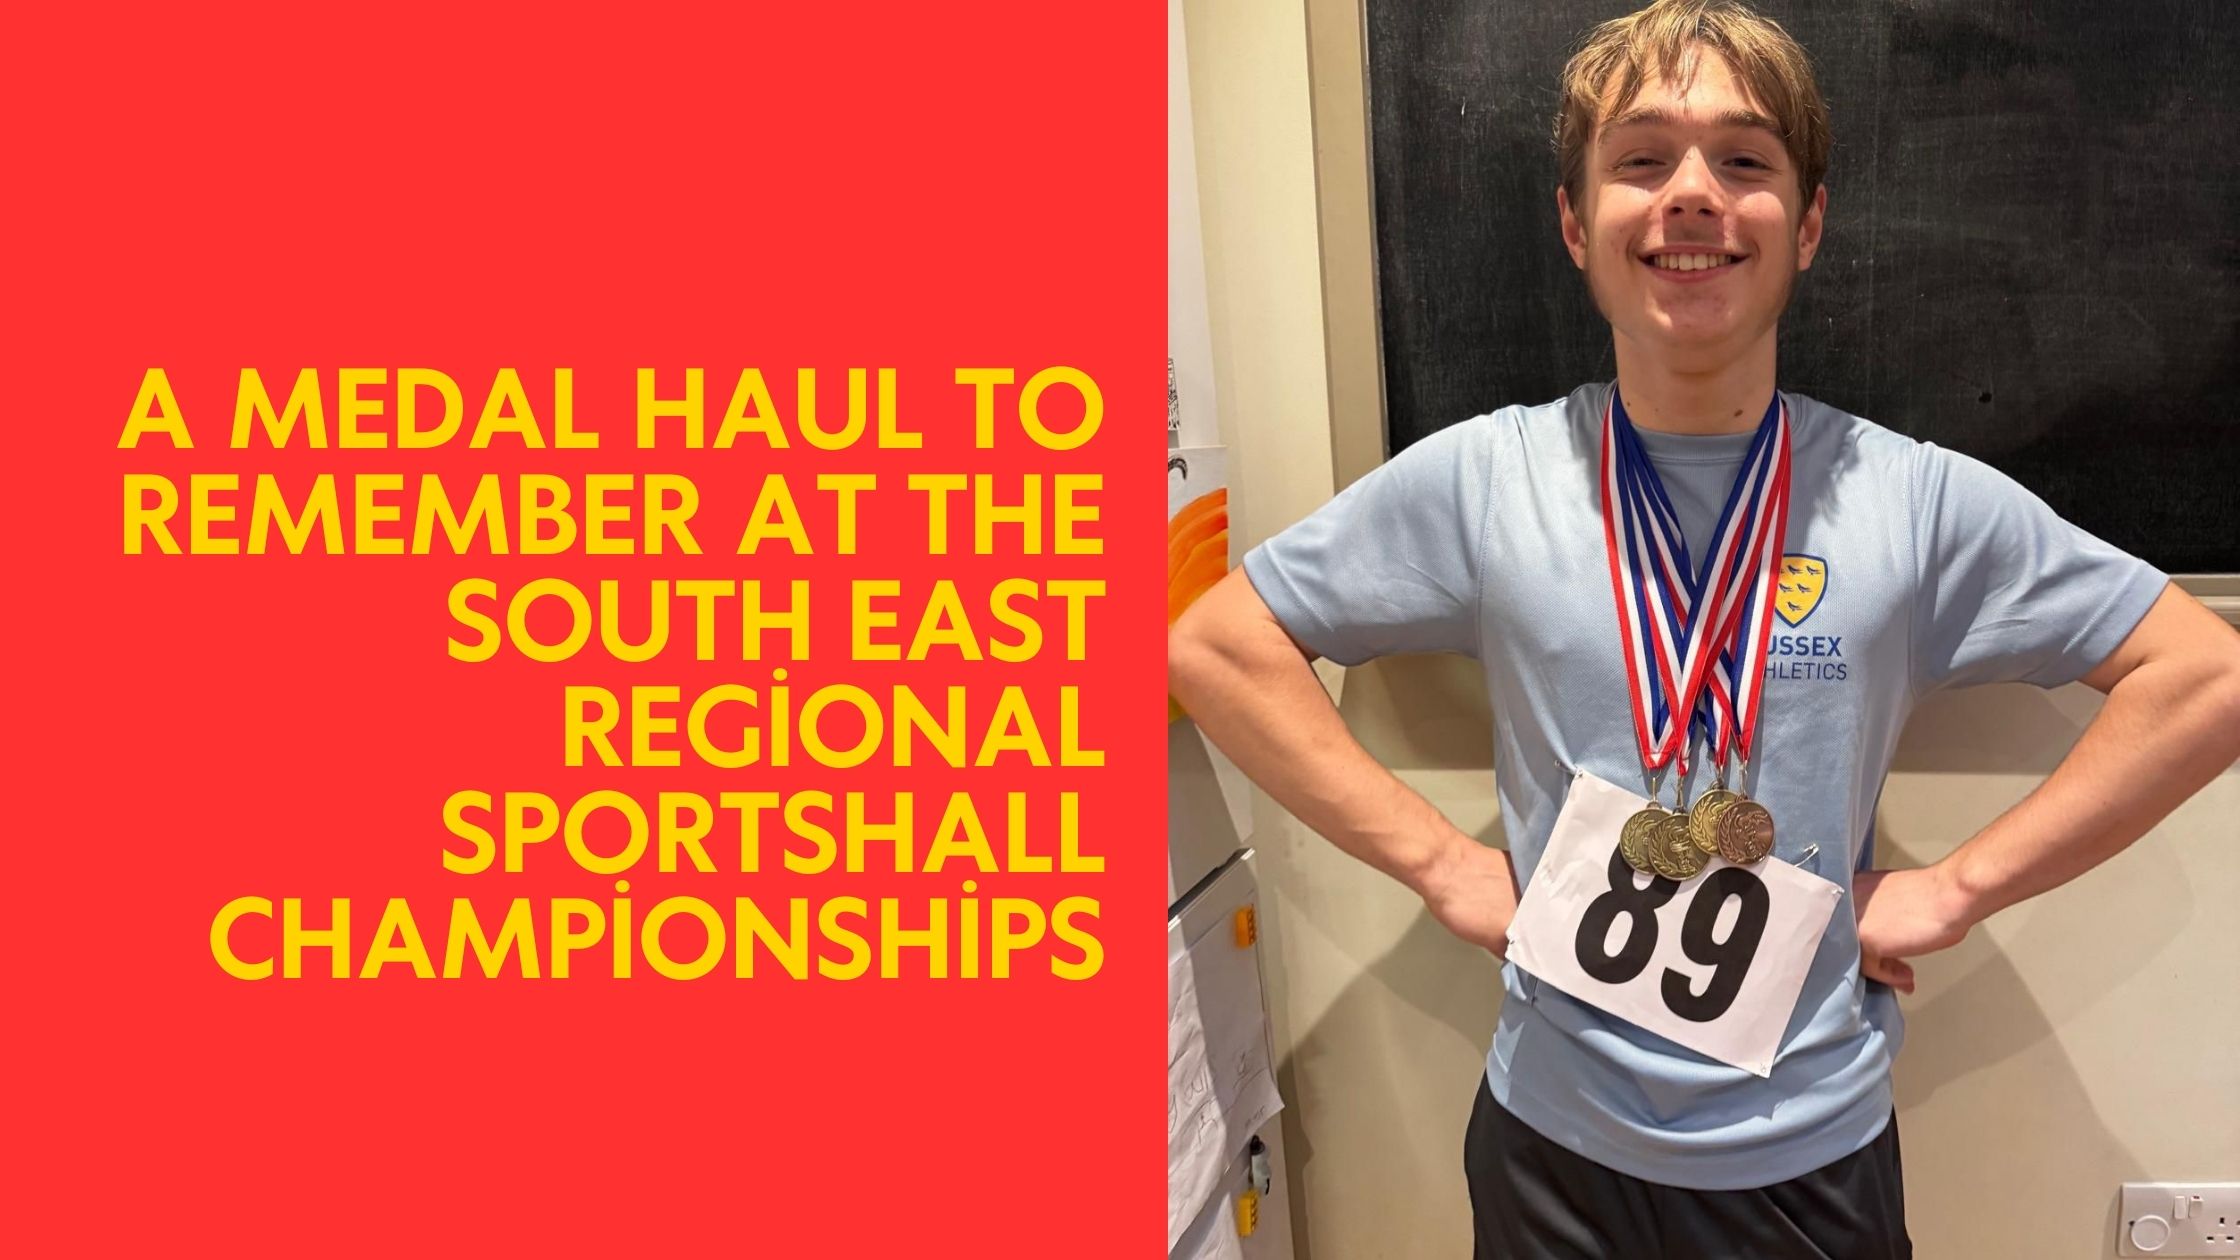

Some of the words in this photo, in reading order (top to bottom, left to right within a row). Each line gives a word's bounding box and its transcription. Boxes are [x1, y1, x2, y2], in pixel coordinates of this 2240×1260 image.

[1767, 635, 1842, 657] USSEX
[1764, 661, 1847, 680] HLETICS
[1575, 842, 1770, 1023] 89
